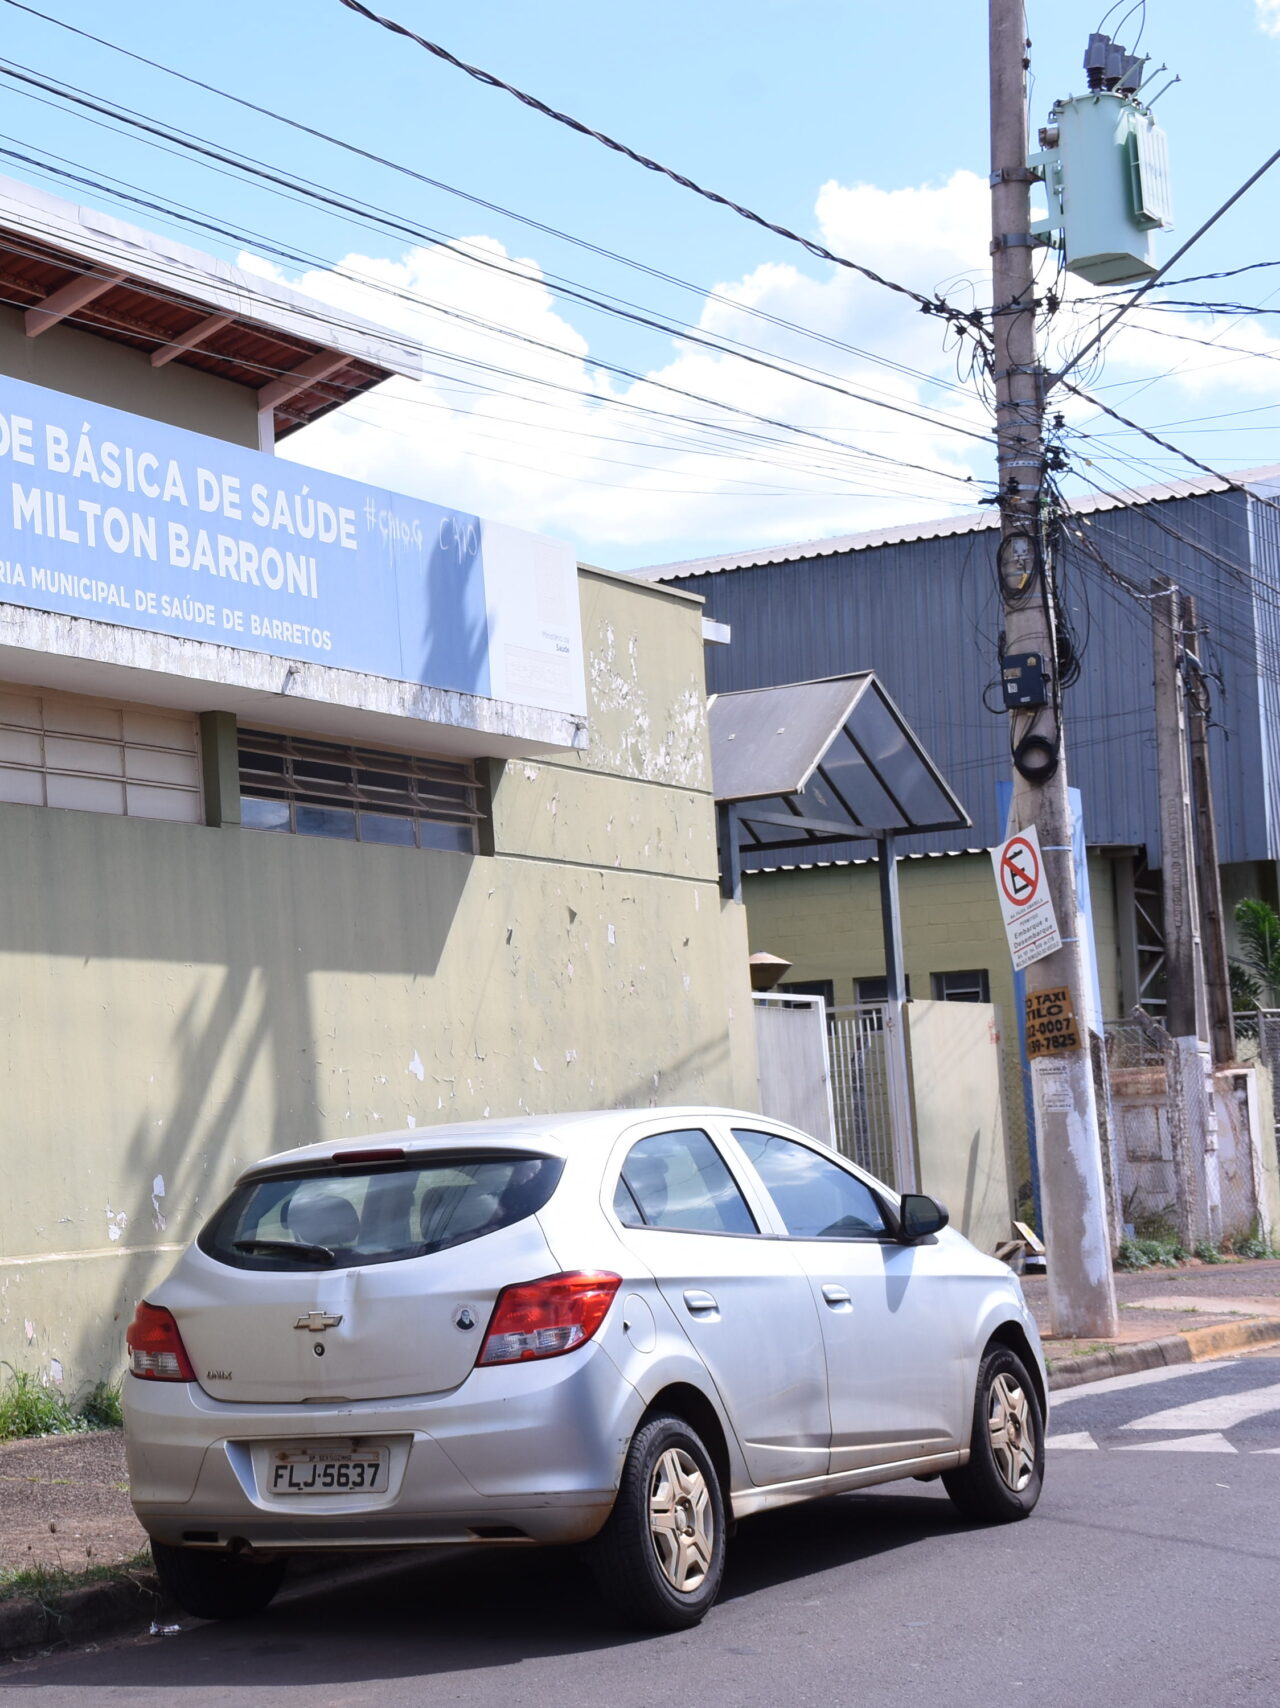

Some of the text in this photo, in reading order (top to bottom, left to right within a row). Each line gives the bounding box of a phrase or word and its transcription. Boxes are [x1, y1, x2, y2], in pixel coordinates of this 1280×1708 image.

[45, 421, 188, 507] BÁSICA
[197, 467, 242, 520] DE
[251, 484, 357, 550] SAÚDE
[12, 482, 157, 561] MILTON
[168, 521, 318, 599] BARRONI
[31, 566, 130, 609] MUNICIPAL
[135, 589, 158, 615] DE
[161, 594, 216, 626] SAÚDE
[223, 608, 244, 632] DE
[250, 614, 332, 651] BARRETOS
[1034, 991, 1067, 1006] TAXI
